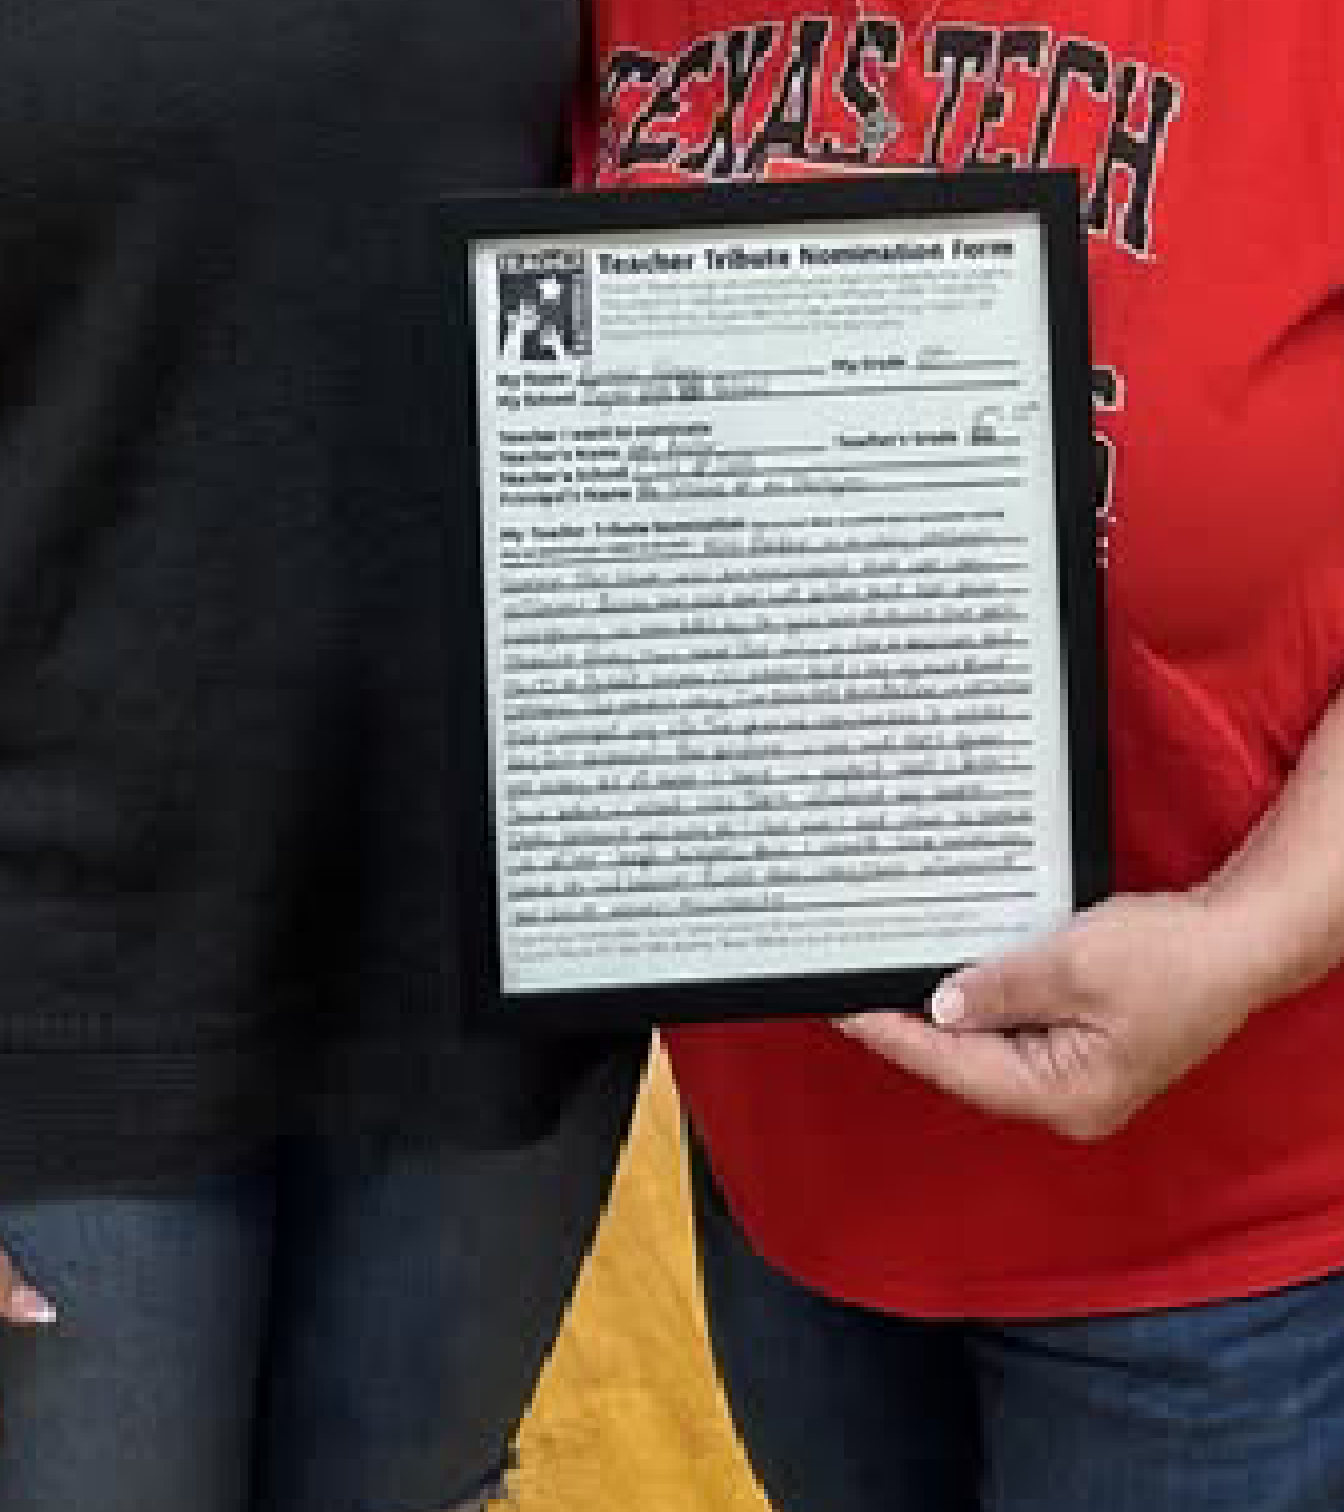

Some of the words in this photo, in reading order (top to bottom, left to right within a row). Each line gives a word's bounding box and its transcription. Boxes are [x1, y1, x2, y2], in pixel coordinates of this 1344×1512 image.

[605, 15, 900, 180] TEXAS
[923, 21, 1184, 264] TECH
[598, 250, 694, 275] Teacher
[703, 246, 792, 272] Tribute
[798, 241, 945, 267] Nomination
[951, 237, 1015, 260] Form
